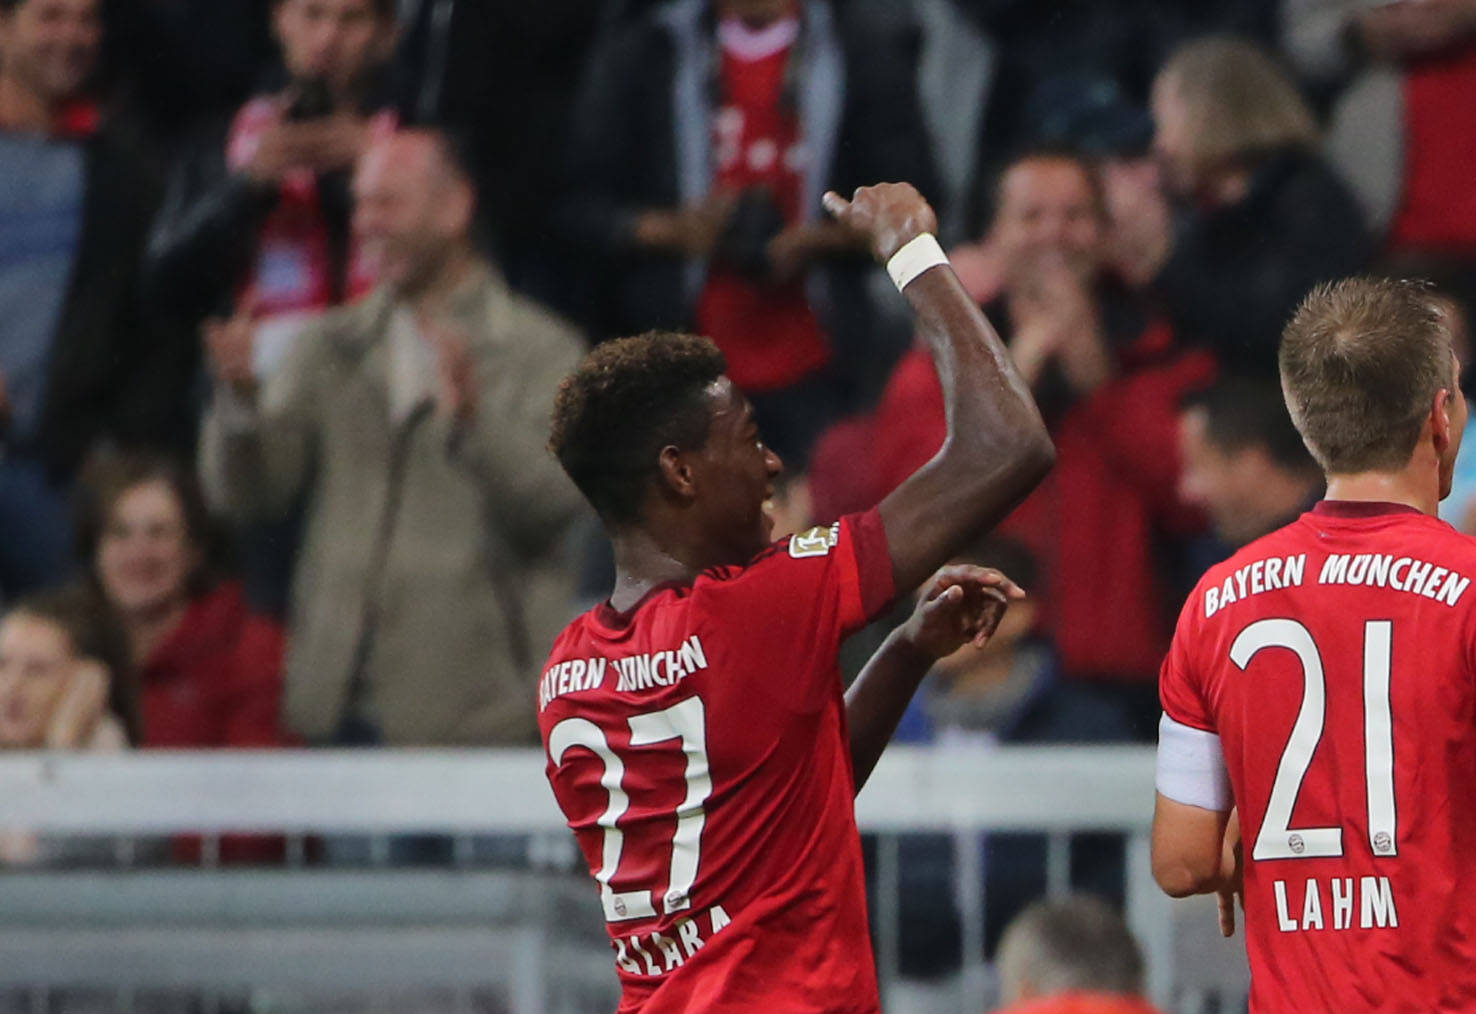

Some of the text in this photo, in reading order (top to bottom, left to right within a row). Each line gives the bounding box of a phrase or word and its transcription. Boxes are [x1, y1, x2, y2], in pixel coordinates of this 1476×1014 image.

[1204, 554, 1471, 618] BAYERN MÜNCHEN
[548, 695, 713, 922] 27
[1228, 617, 1398, 861] 21
[1273, 876, 1399, 932] LAHM
